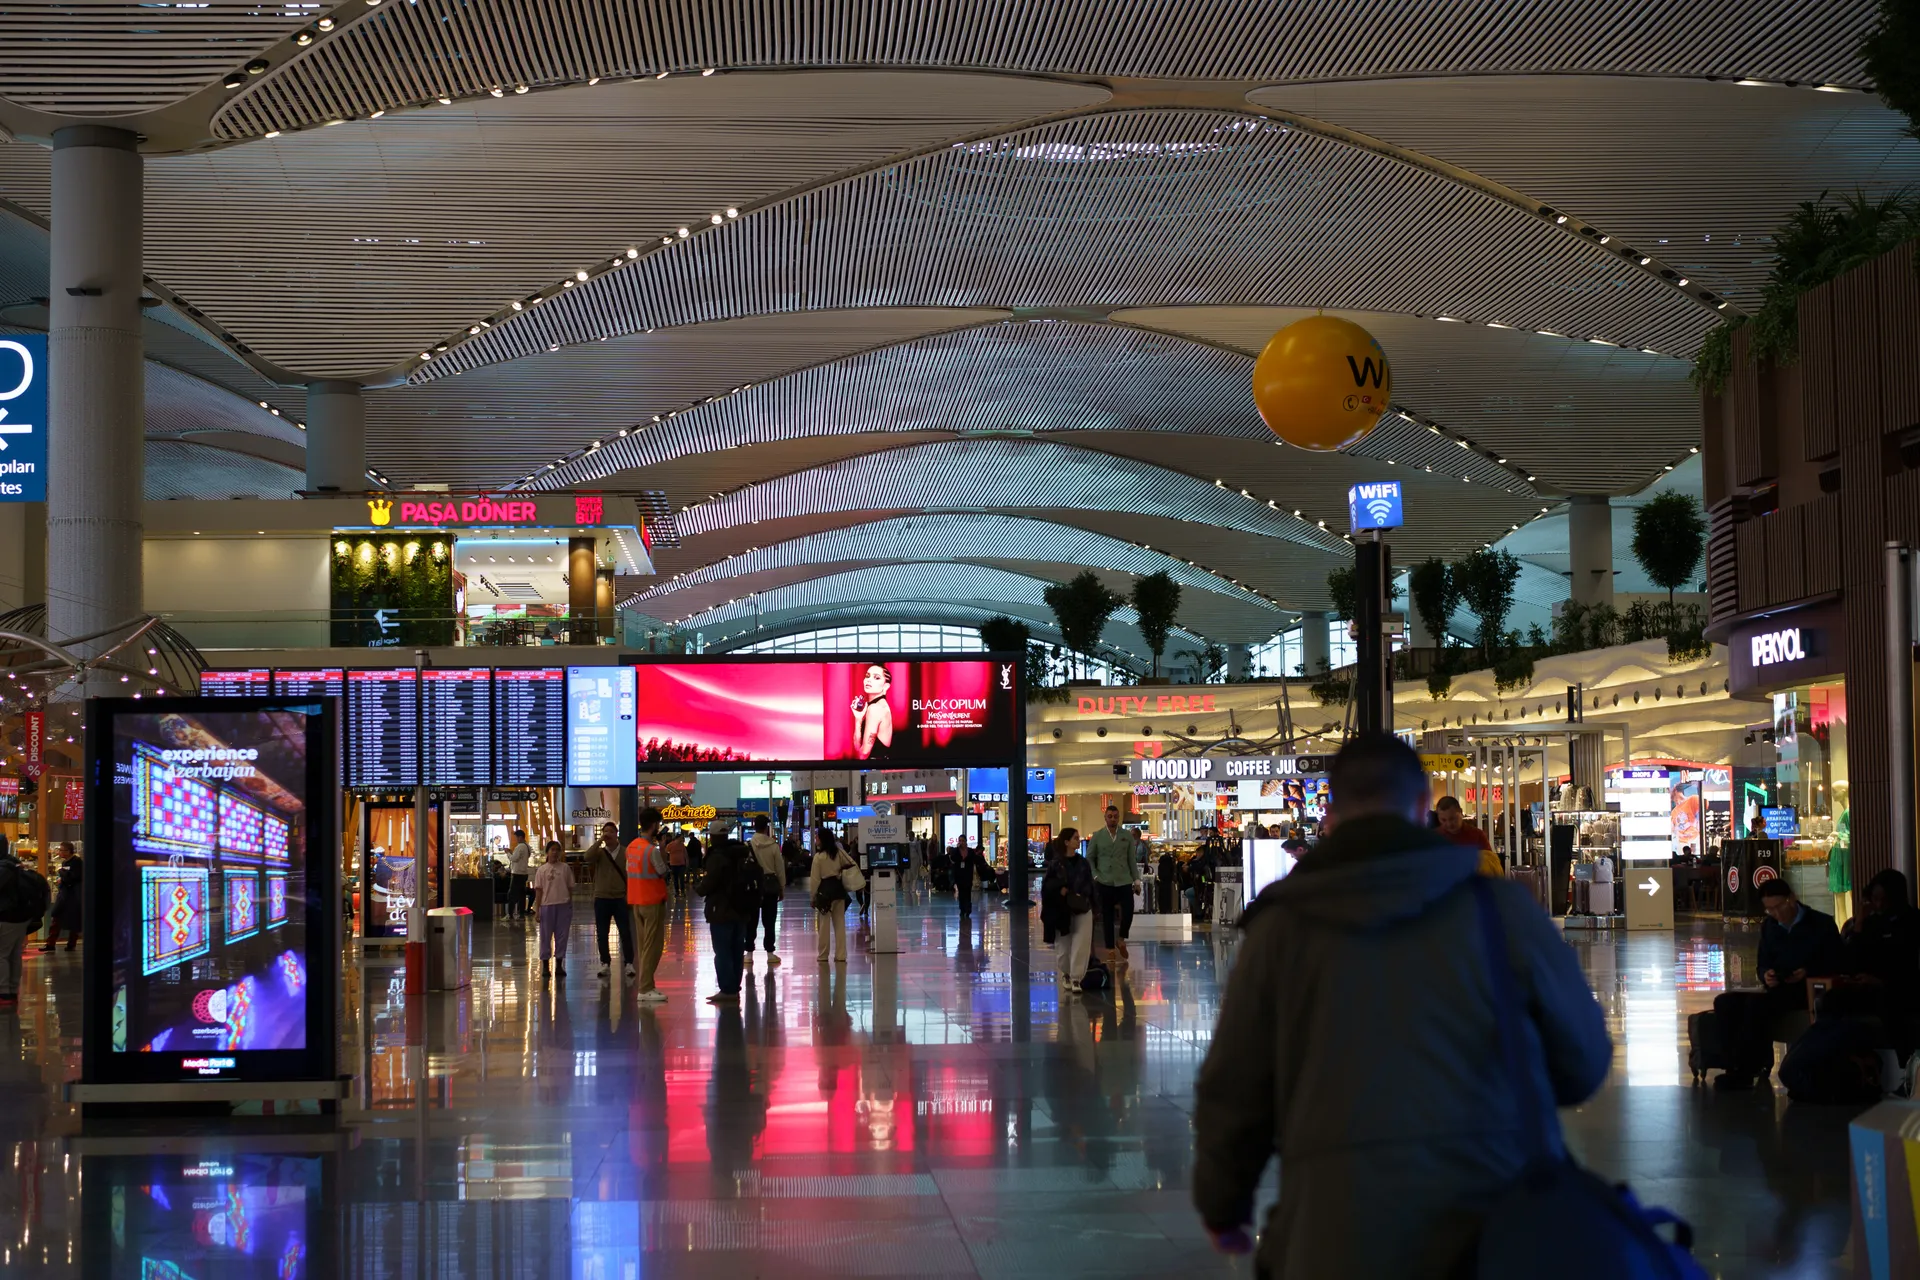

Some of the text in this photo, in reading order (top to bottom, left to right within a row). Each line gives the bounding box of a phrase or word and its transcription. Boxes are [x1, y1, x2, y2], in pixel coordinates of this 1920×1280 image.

[0, 459, 34, 477] pıları
[0, 483, 23, 495] tes
[1358, 484, 1398, 499] WiFi
[401, 498, 537, 526] PAŞA DÖNER
[576, 512, 602, 524] BUT
[913, 699, 986, 710] BLACK OPIUM
[1077, 694, 1216, 714] DUTY FREE
[31, 715, 39, 762] DISCOUNT
[161, 746, 259, 764] experience
[163, 762, 256, 782] Azerbaijan
[1142, 759, 1211, 779] MOOD UP
[1226, 760, 1270, 776] COFFEE
[1276, 760, 1302, 774] JUI
[1757, 850, 1771, 858] F19
[183, 1060, 208, 1068] Media
